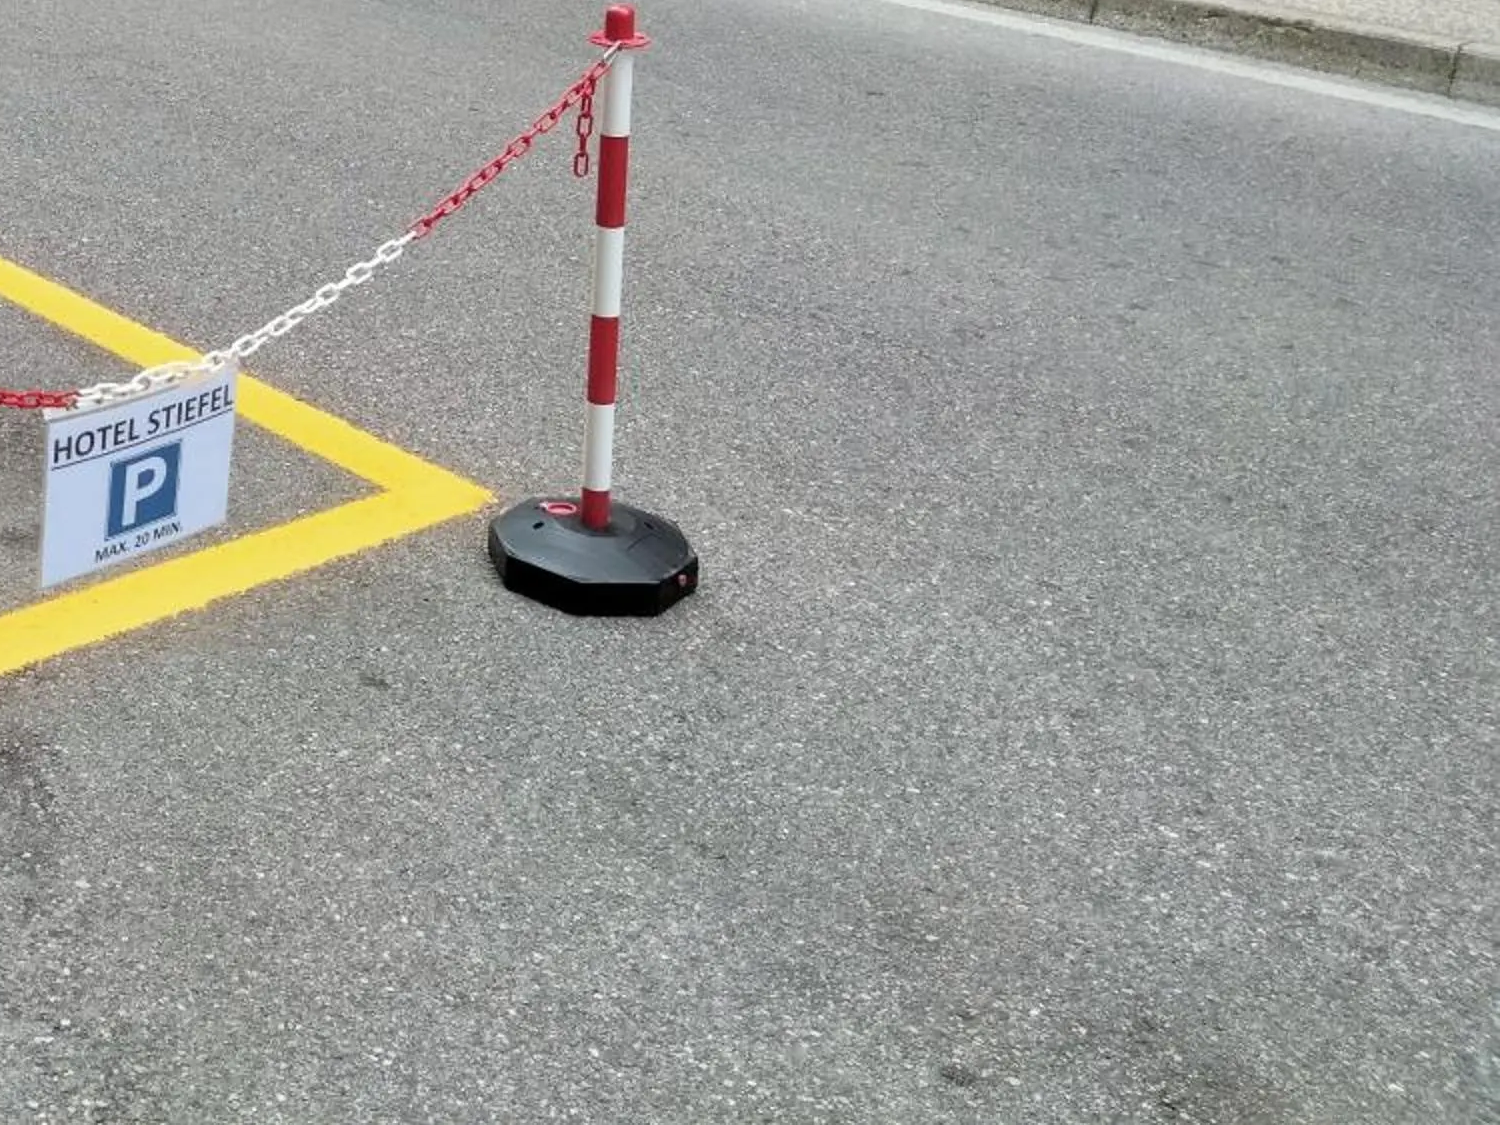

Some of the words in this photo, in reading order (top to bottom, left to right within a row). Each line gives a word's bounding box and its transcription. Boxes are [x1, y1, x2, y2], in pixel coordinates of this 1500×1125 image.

[53, 418, 140, 464] HOTEL
[147, 384, 234, 435] STIEFEL
[121, 456, 168, 526] P
[134, 531, 150, 548] 20
